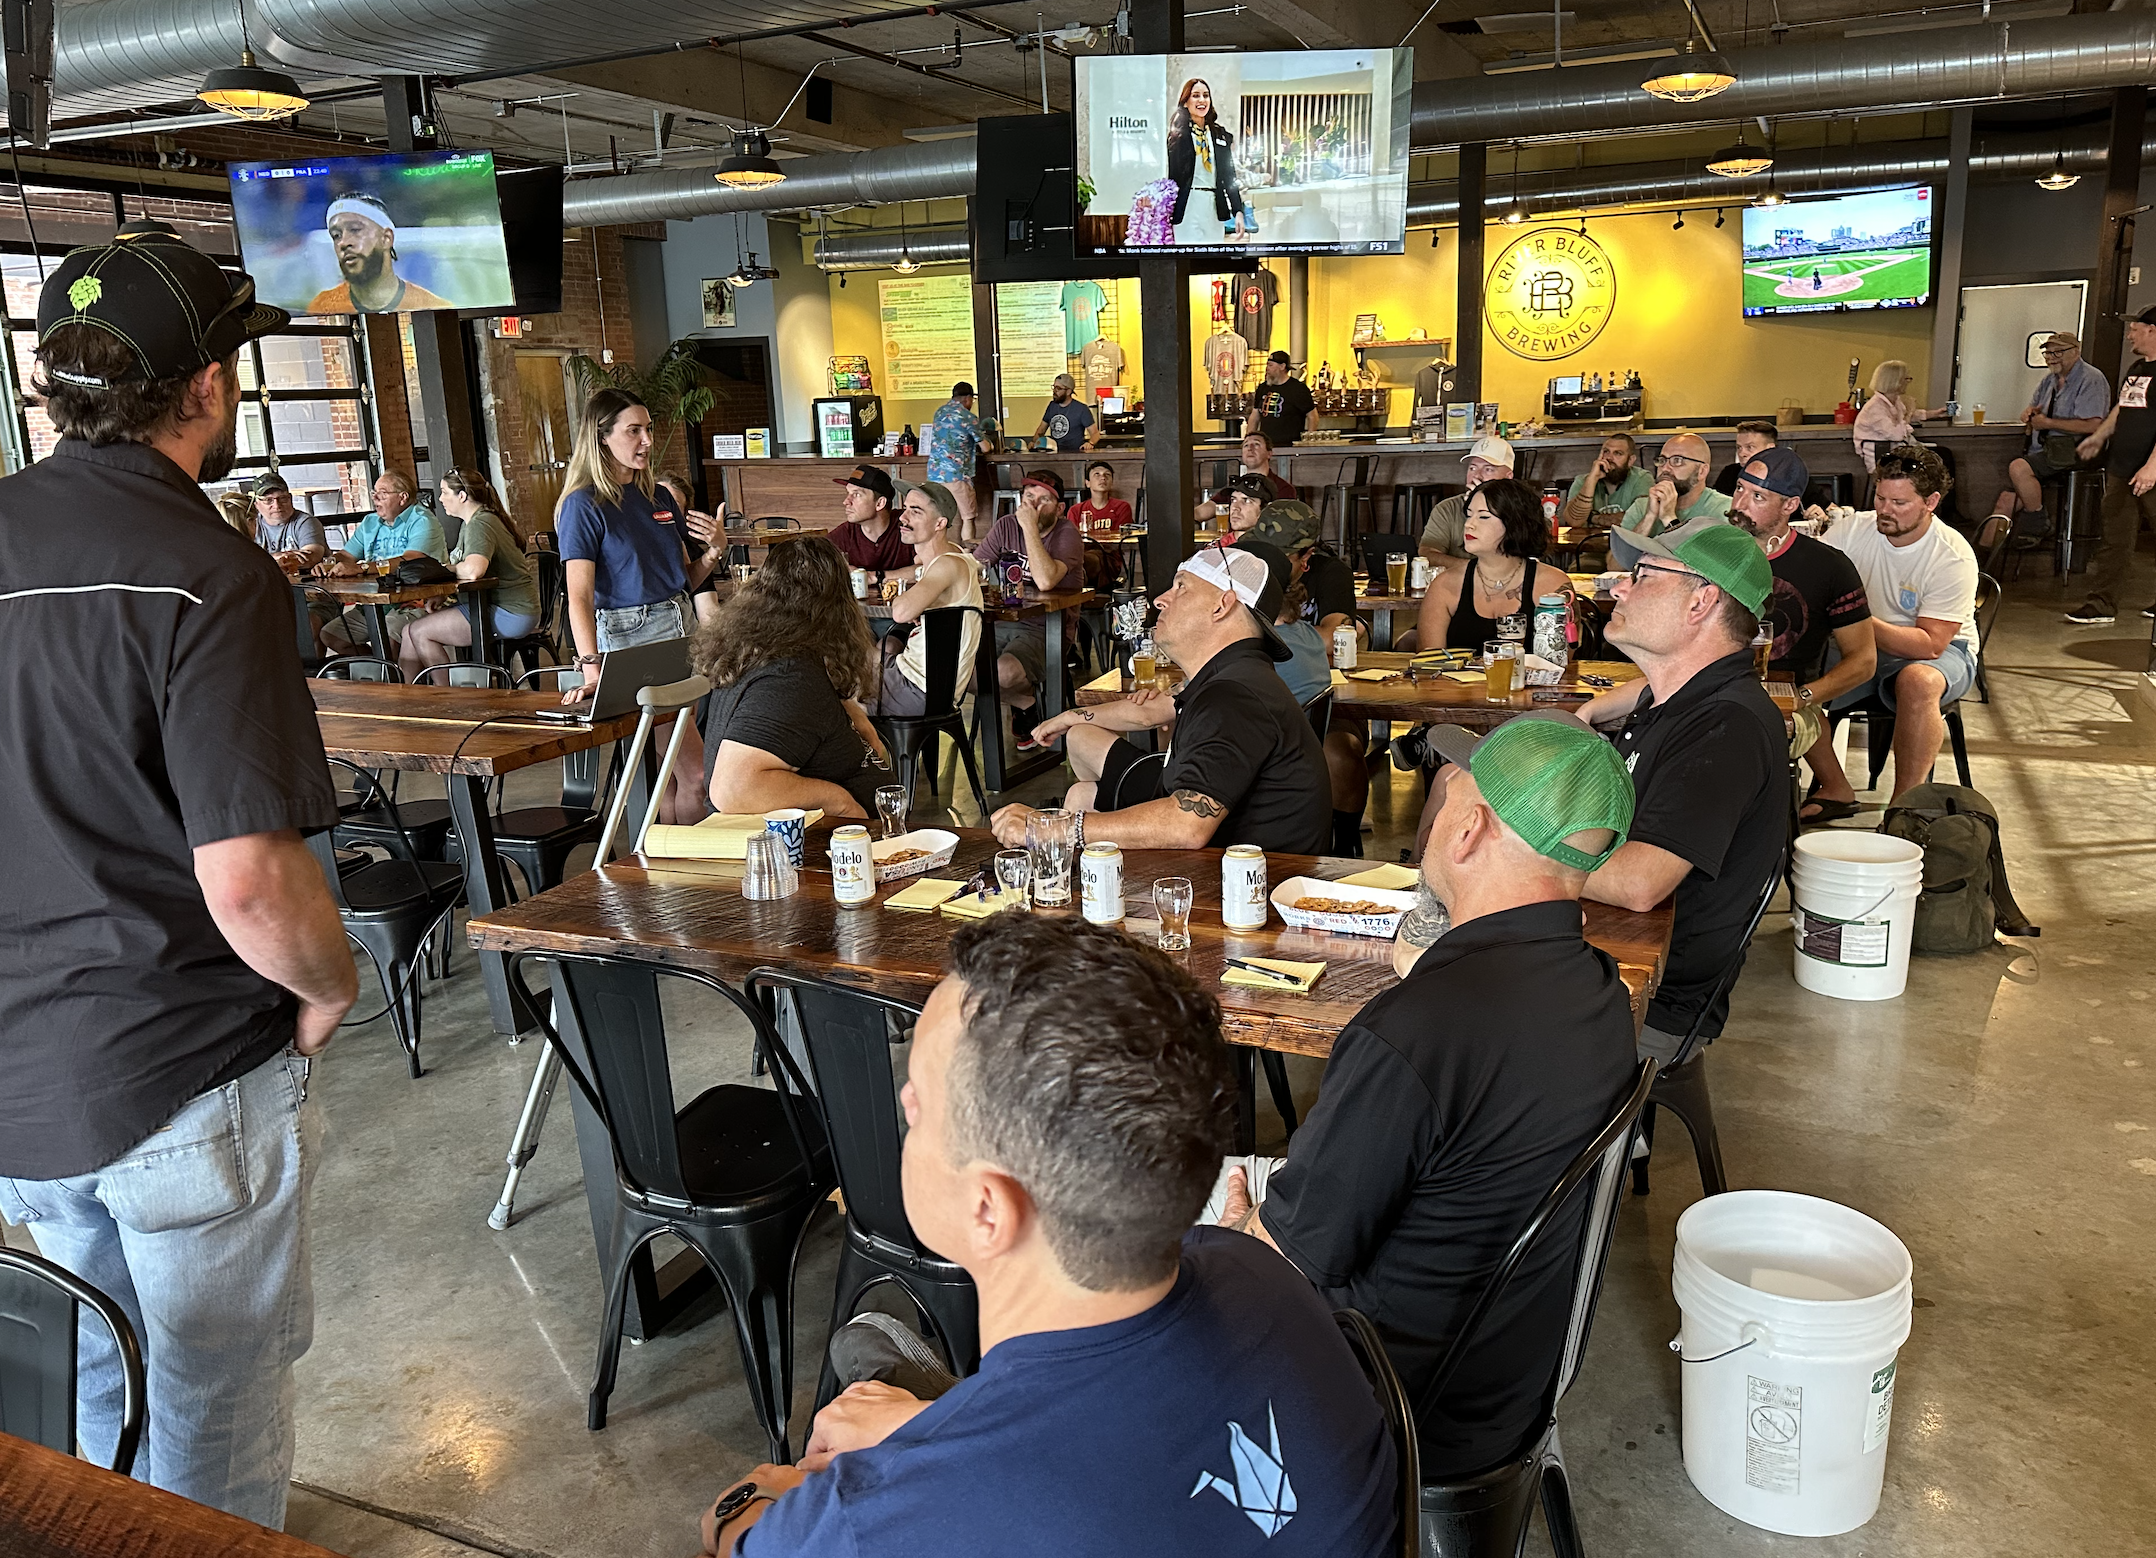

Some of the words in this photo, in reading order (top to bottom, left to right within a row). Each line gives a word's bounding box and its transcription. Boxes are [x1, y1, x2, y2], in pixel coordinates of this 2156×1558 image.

[1109, 116, 1148, 128] Hilton
[471, 154, 486, 163] FOX
[1369, 241, 1389, 251] FS1
[1555, 236, 1605, 276] BLUFF
[502, 317, 520, 336] EXIT
[1505, 321, 1592, 353] BREWING
[833, 850, 862, 865] odelo
[1361, 917, 1391, 926] 1776
